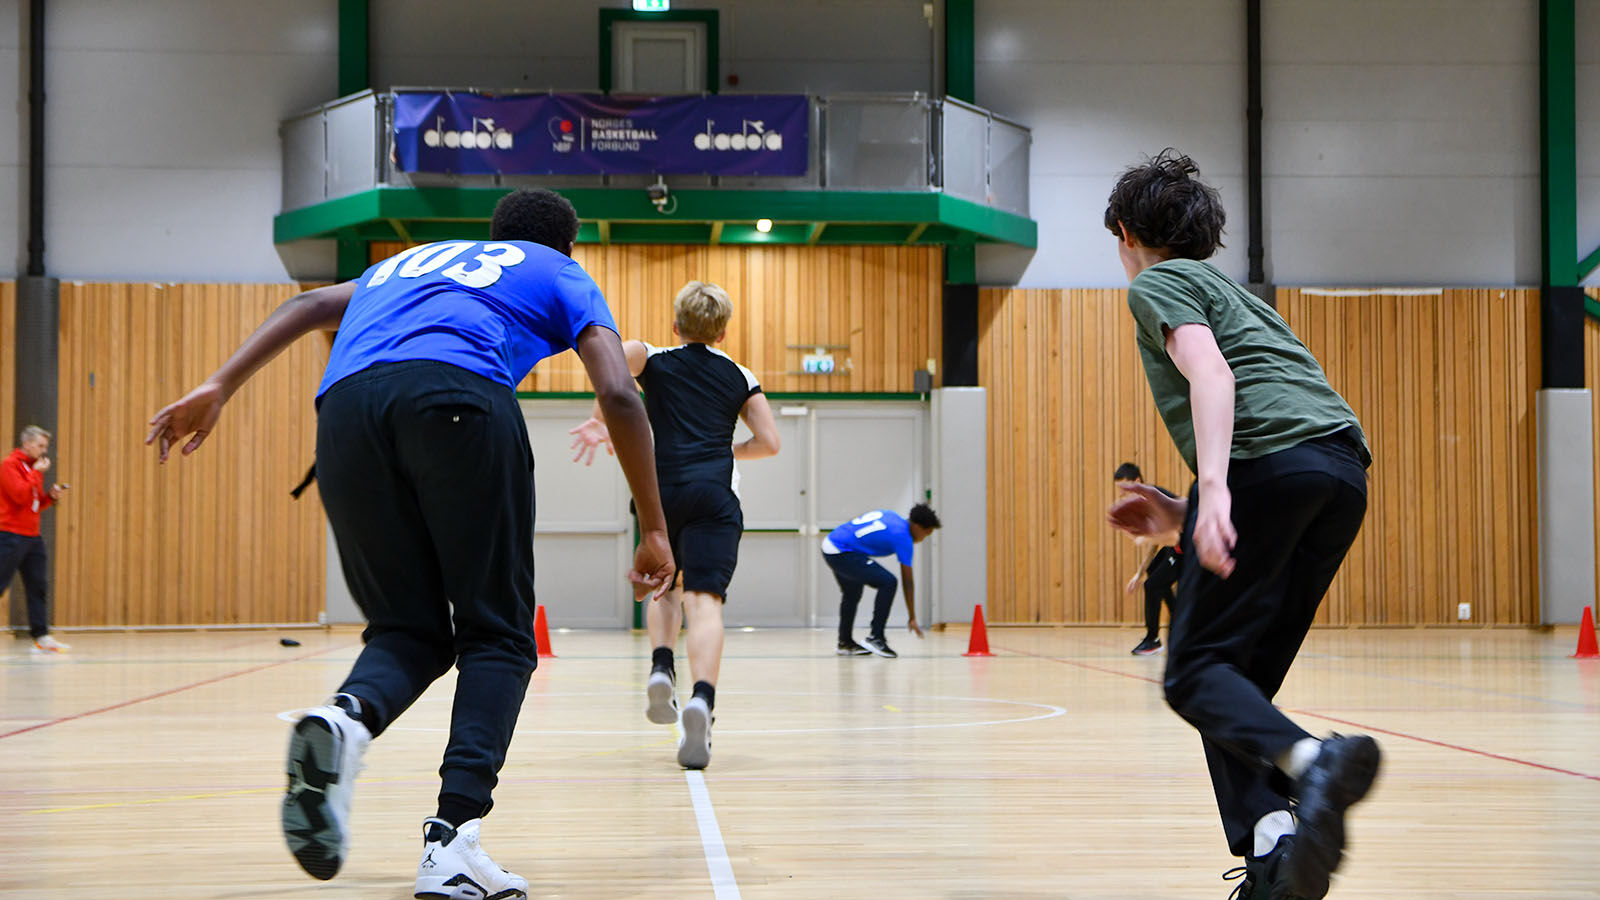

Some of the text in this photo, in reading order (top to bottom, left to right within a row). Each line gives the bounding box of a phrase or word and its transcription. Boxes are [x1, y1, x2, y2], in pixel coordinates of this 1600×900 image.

[424, 116, 512, 149] diadora
[591, 119, 633, 129] NORGES
[591, 130, 657, 140] BASKETBALL
[694, 119, 782, 151] diadora
[591, 141, 640, 152] FORBUND
[366, 242, 526, 289] 103
